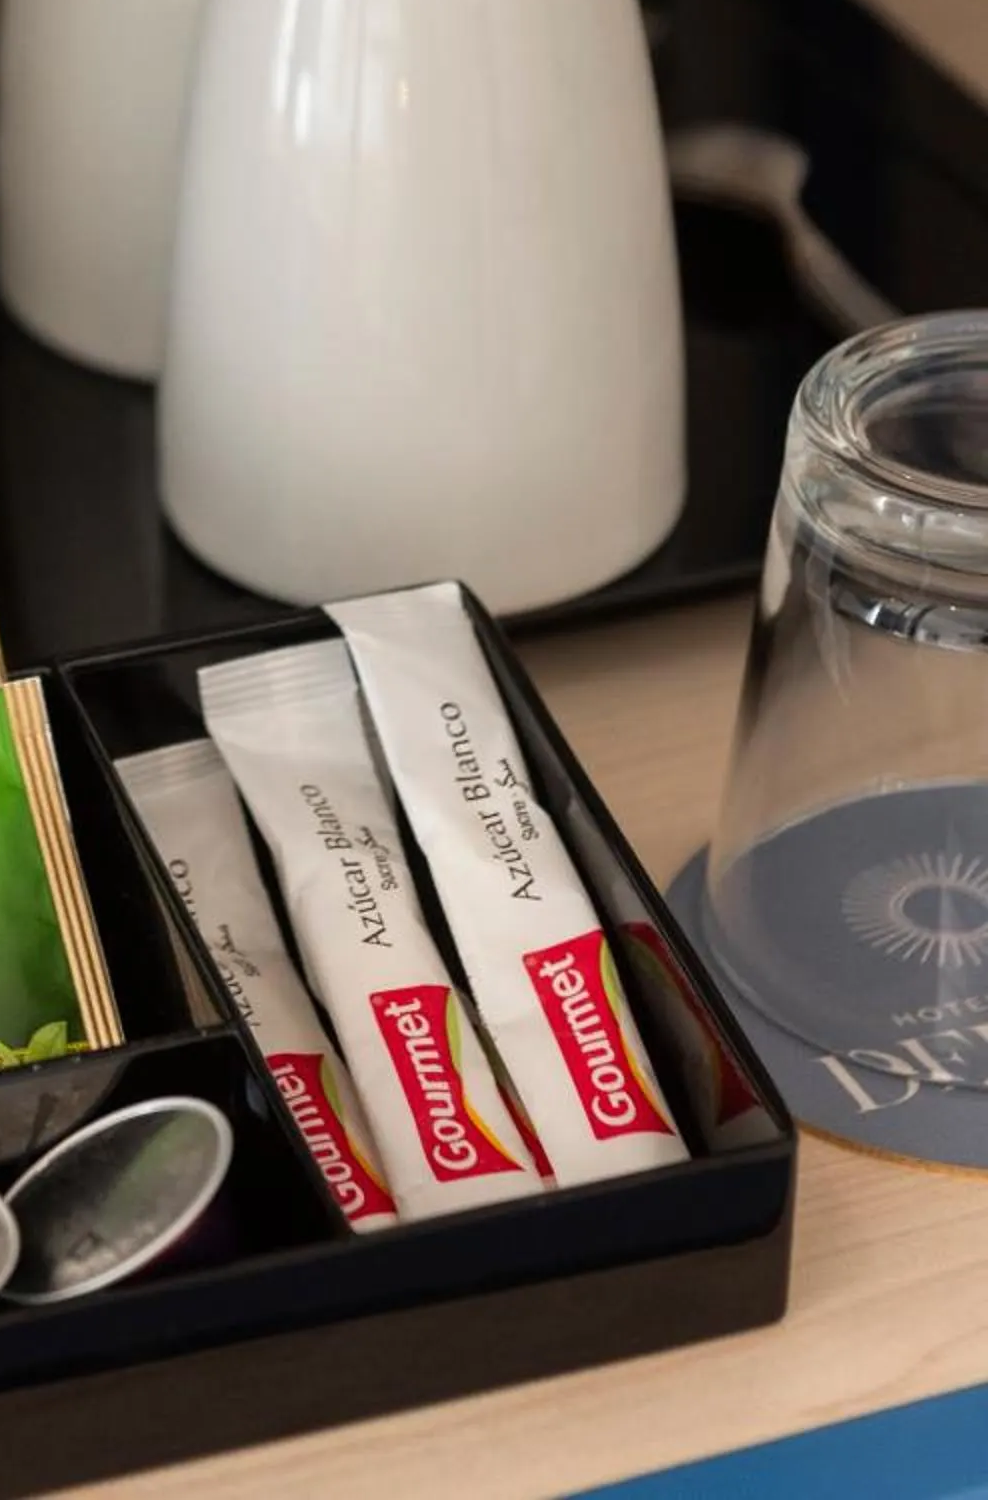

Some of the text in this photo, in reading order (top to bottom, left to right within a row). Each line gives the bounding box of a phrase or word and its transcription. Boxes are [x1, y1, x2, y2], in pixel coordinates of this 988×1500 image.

[299, 783, 393, 948] Azúcar Blanco
[440, 700, 543, 902] Azúcar Blanco
[383, 997, 479, 1171] Gourmet
[539, 952, 637, 1127] Gourmet
[890, 994, 988, 1028] HOTE
